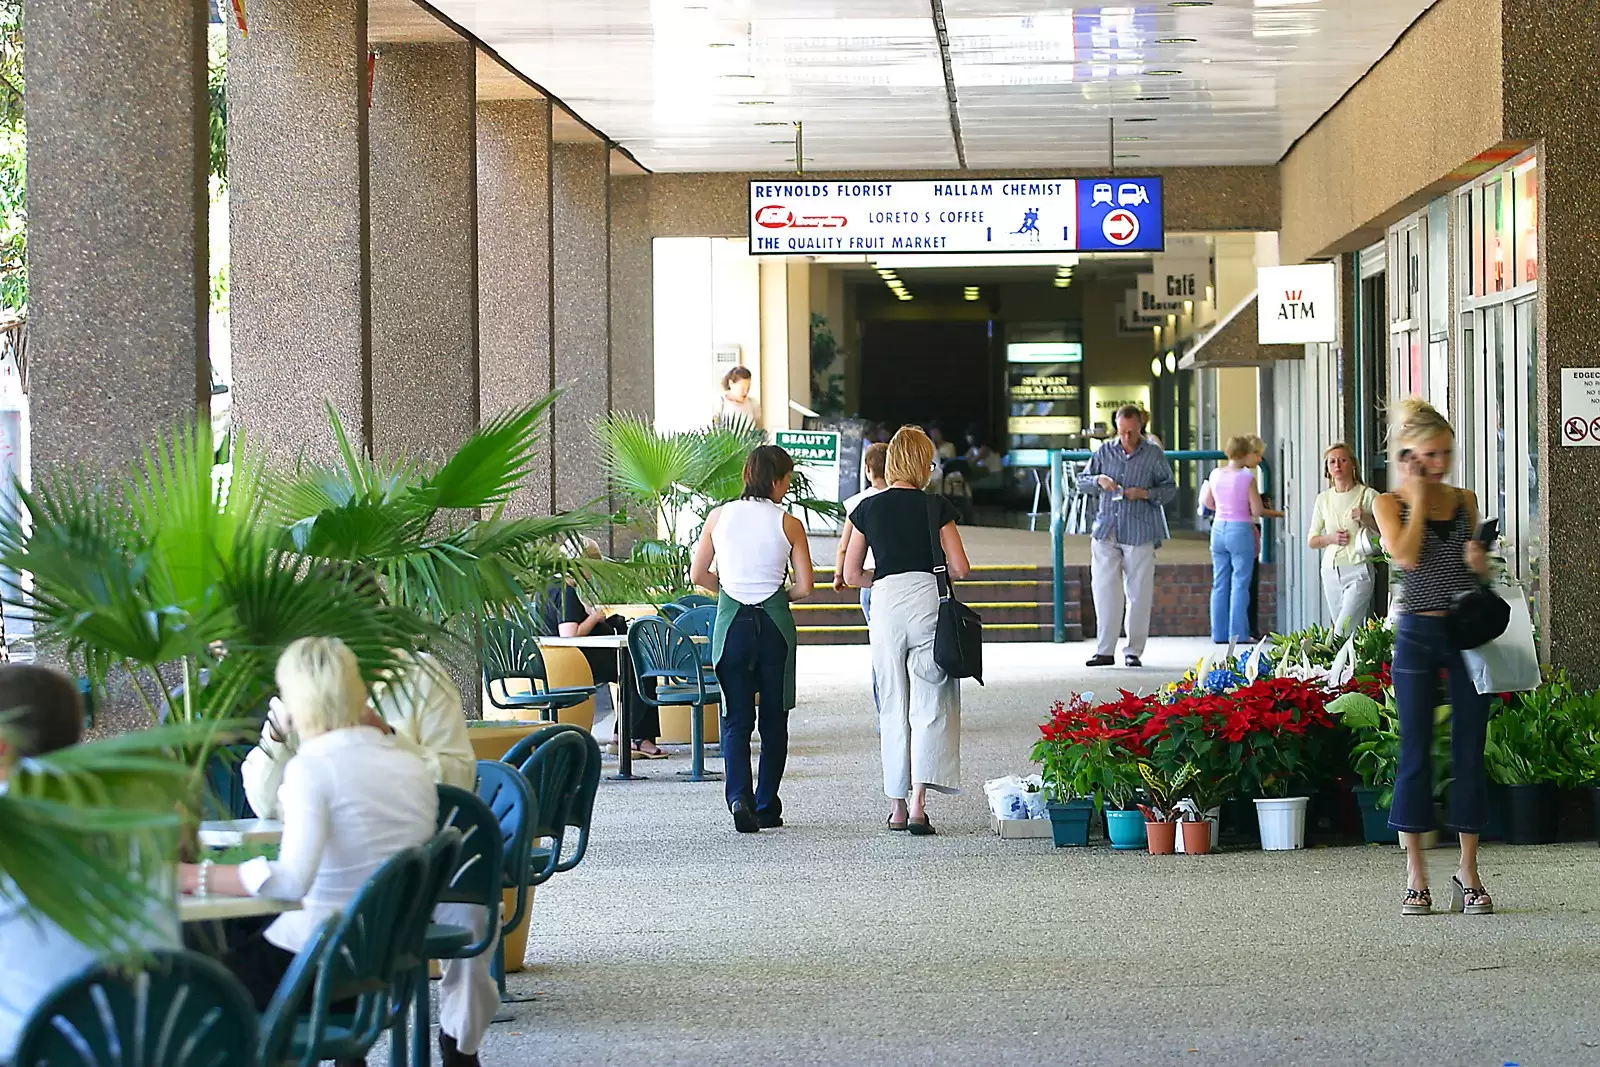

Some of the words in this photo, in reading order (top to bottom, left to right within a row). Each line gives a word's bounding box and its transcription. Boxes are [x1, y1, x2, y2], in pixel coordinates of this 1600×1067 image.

[755, 184, 829, 198] REYNOLDS
[837, 184, 892, 197] FLORIST
[934, 184, 993, 197] HALLAM
[1002, 183, 1062, 196] CHEMIST
[939, 211, 984, 223] COFFEE
[757, 237, 780, 249] THE
[788, 237, 843, 250] QUALITY
[849, 237, 885, 249] FRUIT
[891, 236, 947, 249] MARKET
[1166, 273, 1196, 296] Café
[1277, 301, 1315, 320] ATM
[781, 433, 831, 446] BEAUTY
[784, 448, 835, 459] HERAPY
